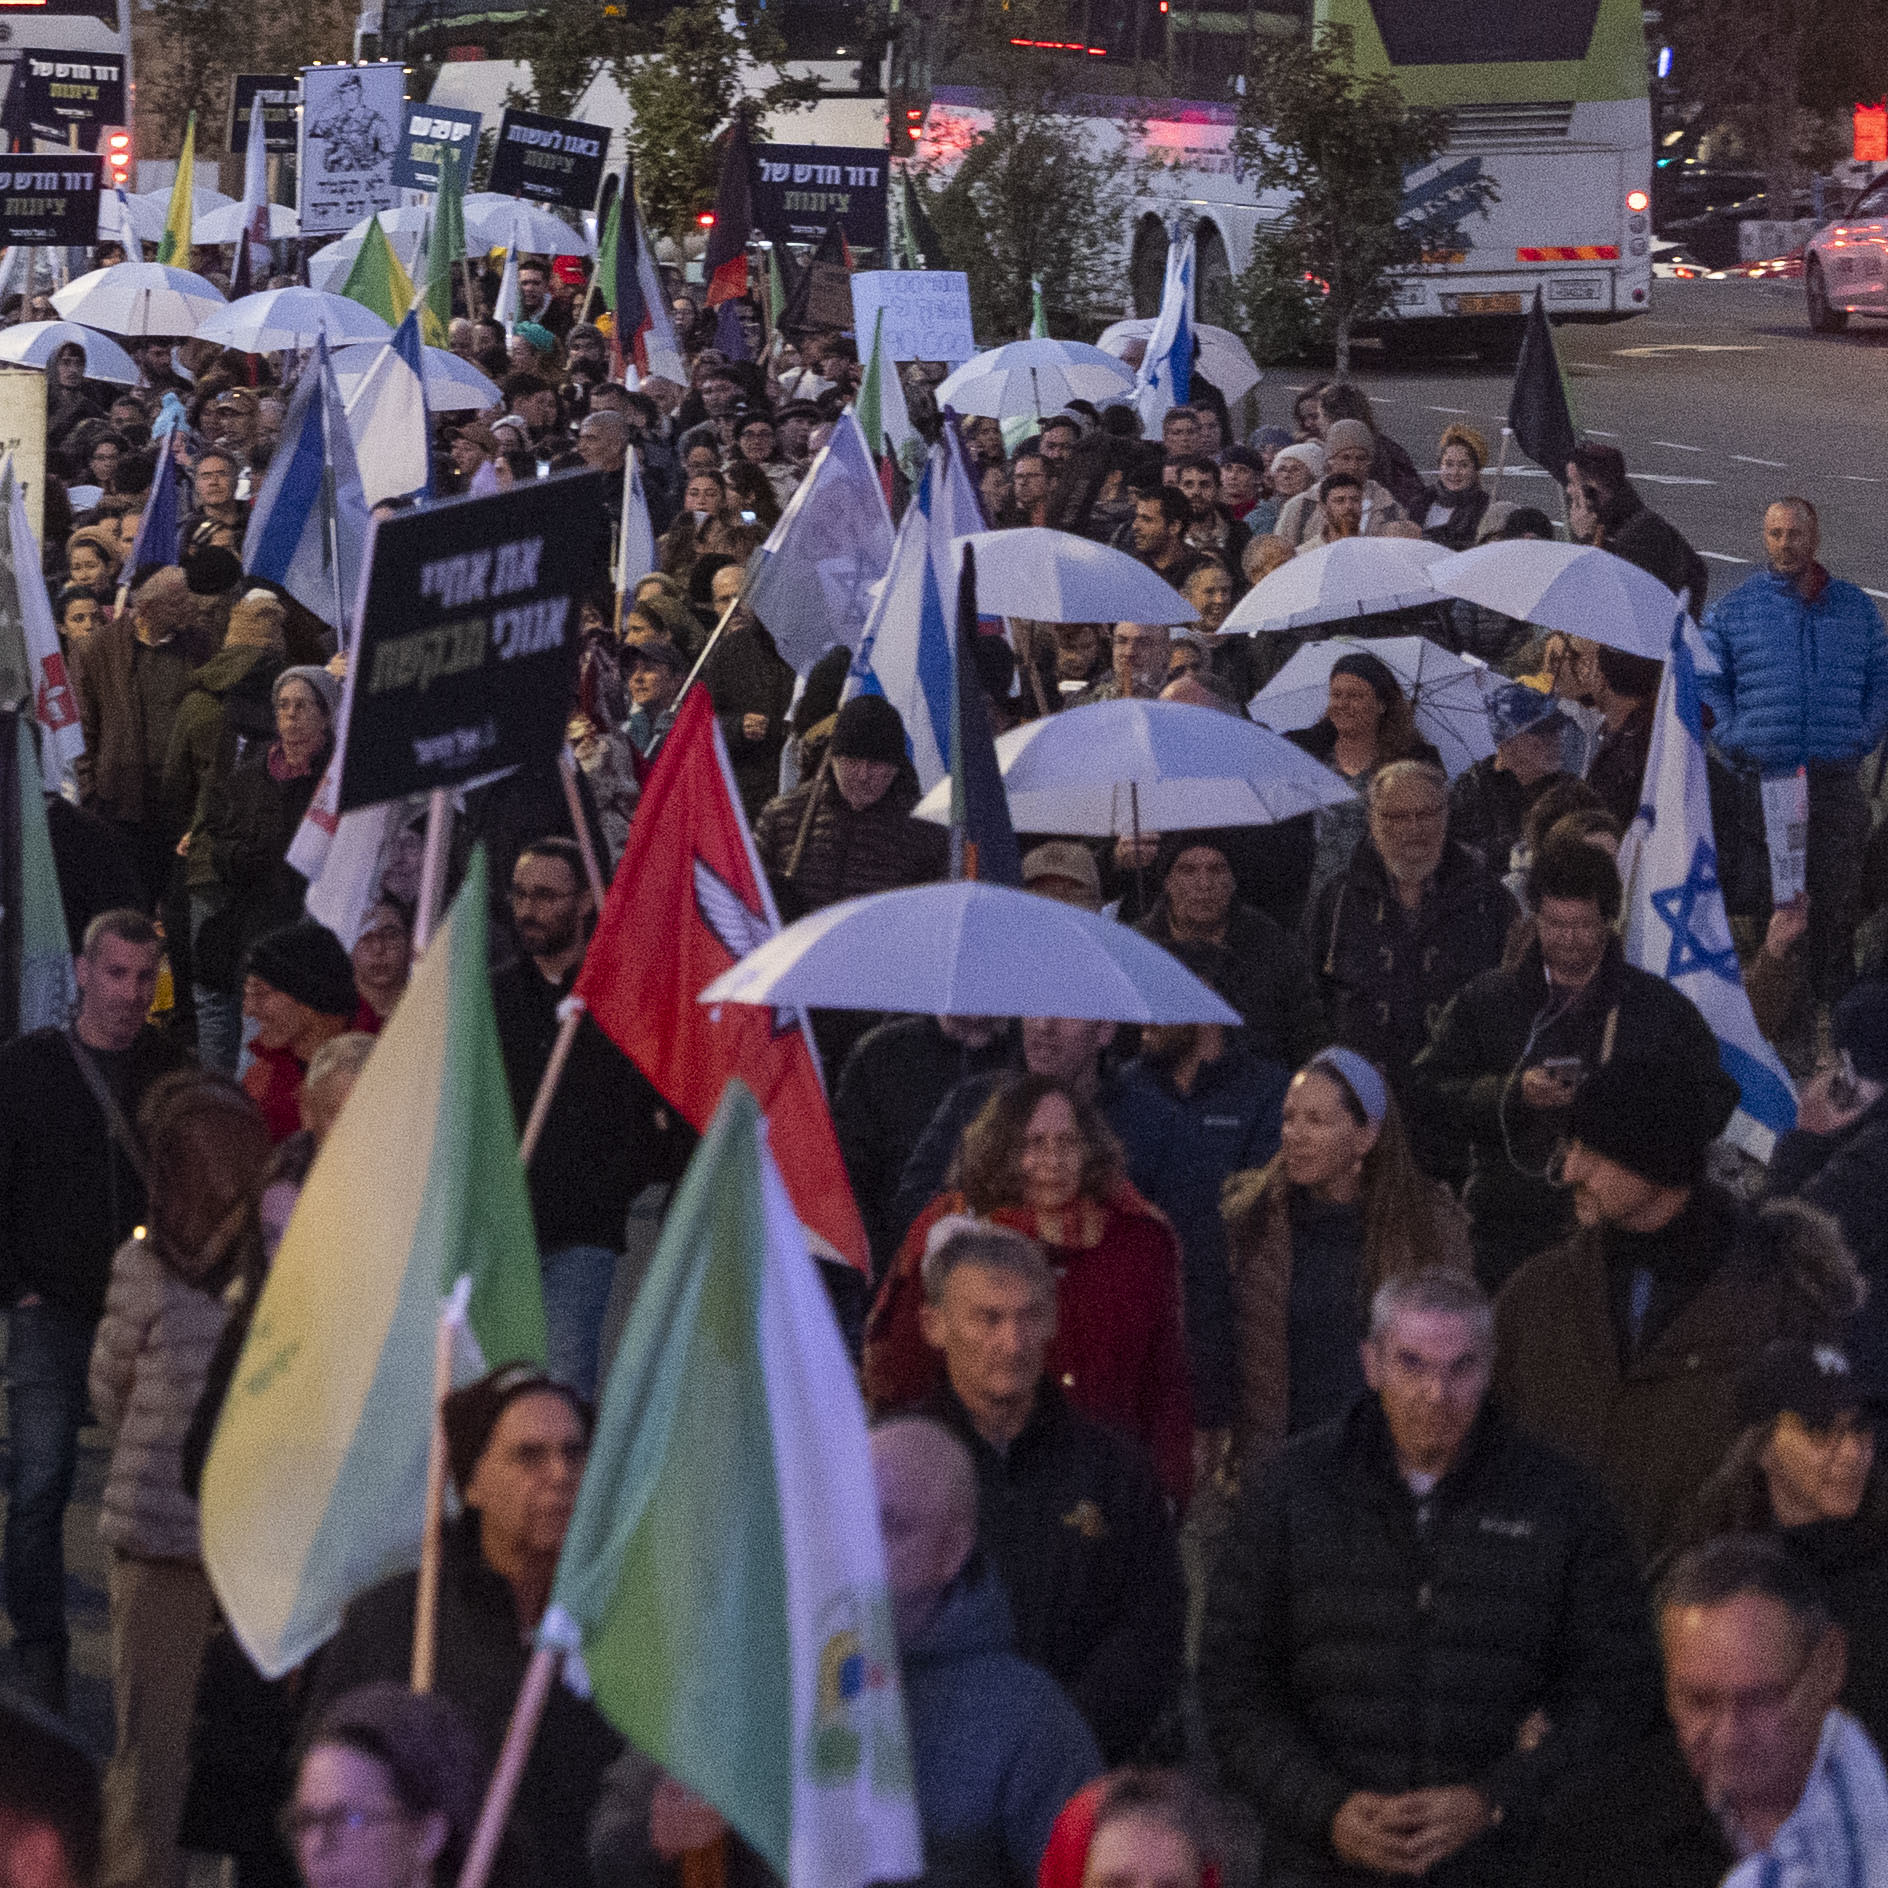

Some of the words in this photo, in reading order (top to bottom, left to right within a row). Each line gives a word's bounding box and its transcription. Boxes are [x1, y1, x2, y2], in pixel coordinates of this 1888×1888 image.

[28, 58, 55, 77] של
[55, 62, 92, 80] חדש
[91, 64, 119, 82] דור
[506, 123, 563, 151] לעשות
[14, 171, 60, 192] חדש
[61, 171, 95, 192] דור
[758, 158, 791, 184] של
[792, 163, 842, 186] חדש
[843, 165, 881, 188] דור
